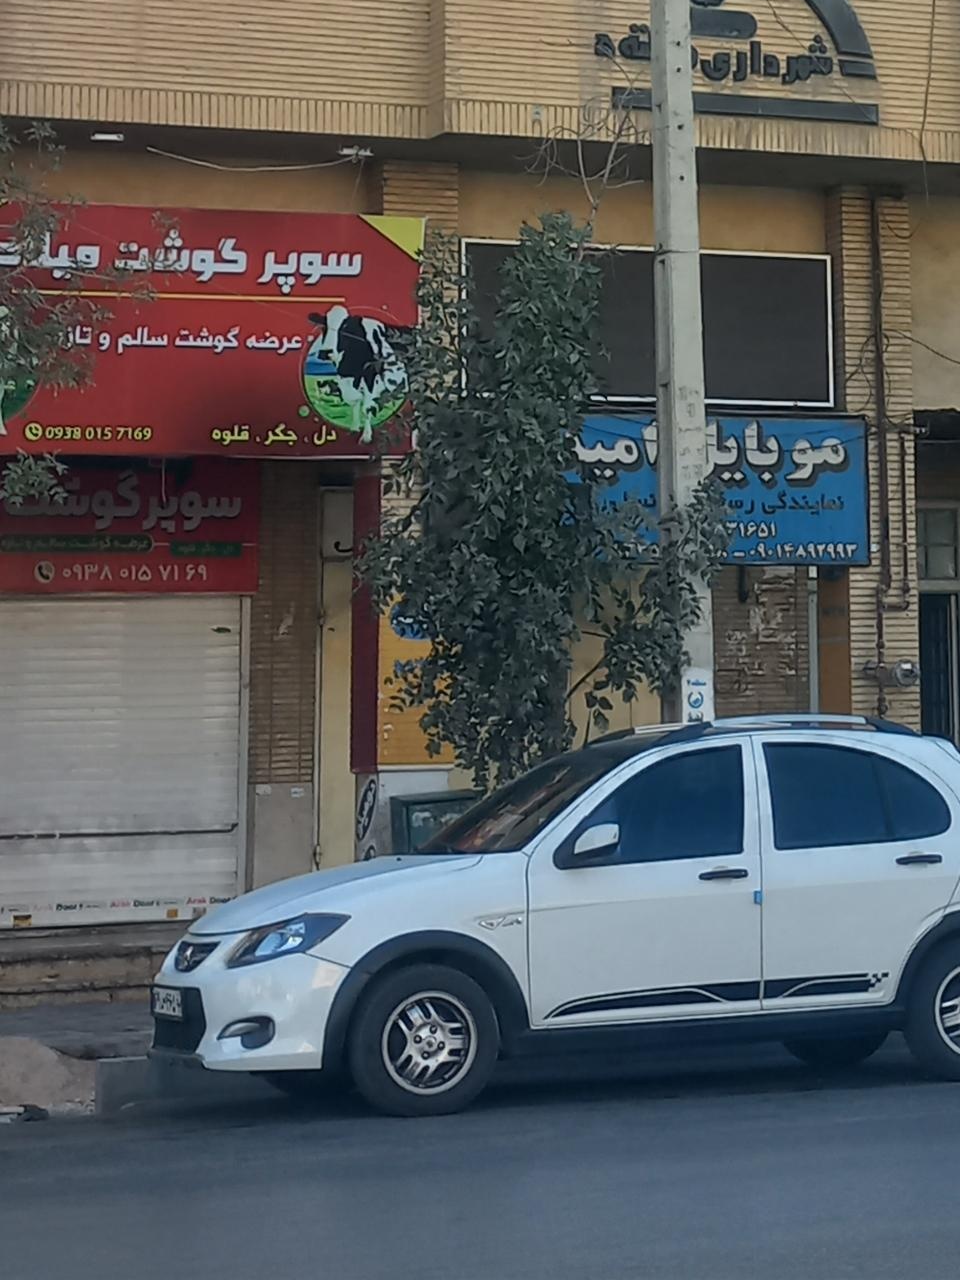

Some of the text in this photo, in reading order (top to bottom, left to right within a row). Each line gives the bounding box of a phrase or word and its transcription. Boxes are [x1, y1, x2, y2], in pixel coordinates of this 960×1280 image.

[700, 34, 834, 86] شهرداری
[114, 228, 248, 283] گوشت
[256, 251, 363, 295] سوپر
[60, 324, 302, 355] عرضه گوشت سالم و تاز
[45, 426, 152, 441] 0938 015 7169
[142, 490, 242, 533] سوپر
[761, 490, 845, 516] نمایندگی
